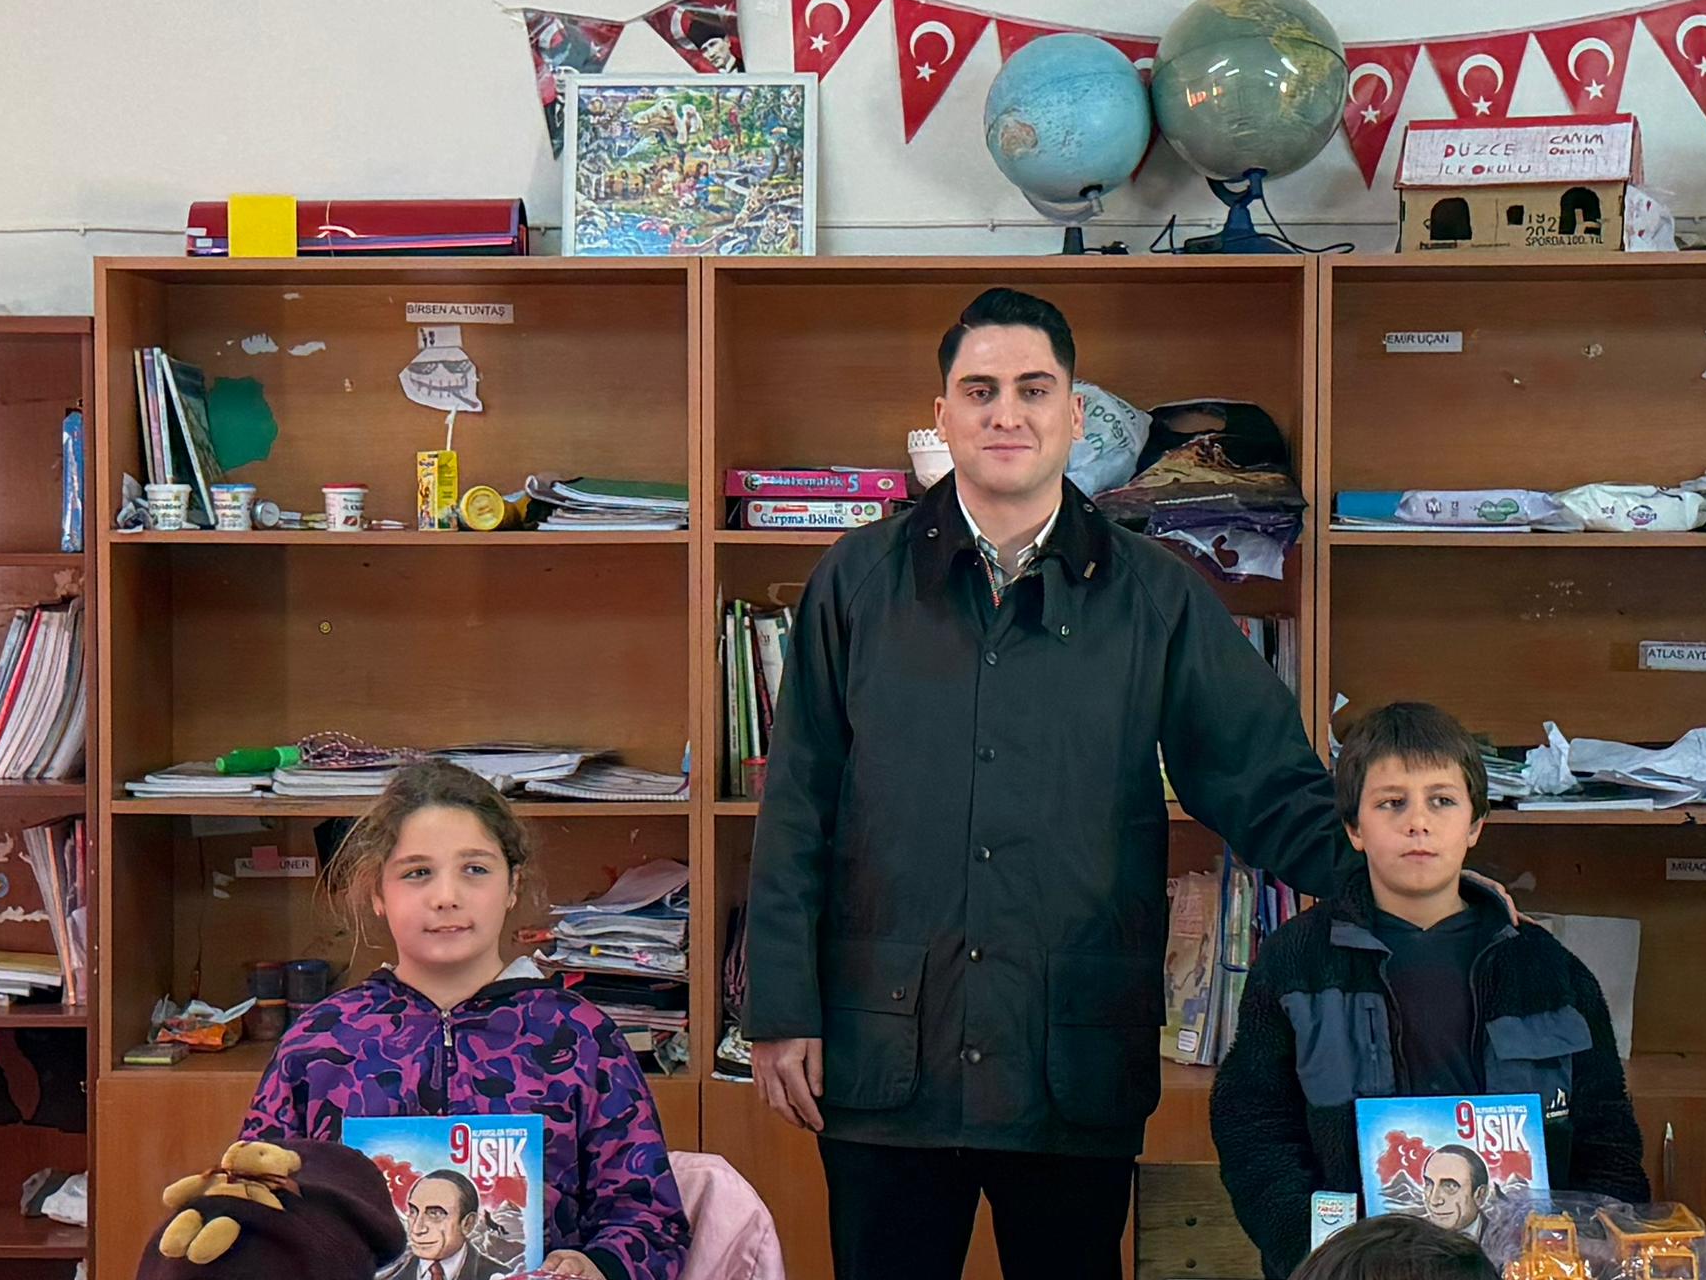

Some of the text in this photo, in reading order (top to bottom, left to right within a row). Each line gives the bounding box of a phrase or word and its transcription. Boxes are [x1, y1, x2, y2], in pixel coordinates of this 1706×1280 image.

[1549, 132, 1604, 145] CANIM
[1444, 142, 1516, 158] DÜZCE
[1471, 163, 1532, 176] OKULU
[1525, 234, 1565, 247] SPORDA
[407, 303, 506, 317] BİRSEN ALTUNTAŞ
[1417, 334, 1450, 347] UÇAN
[1648, 648, 1684, 660] ATLAS
[1455, 1100, 1530, 1160] 9 IŞIK
[449, 1123, 529, 1187] 9 IŞIK
